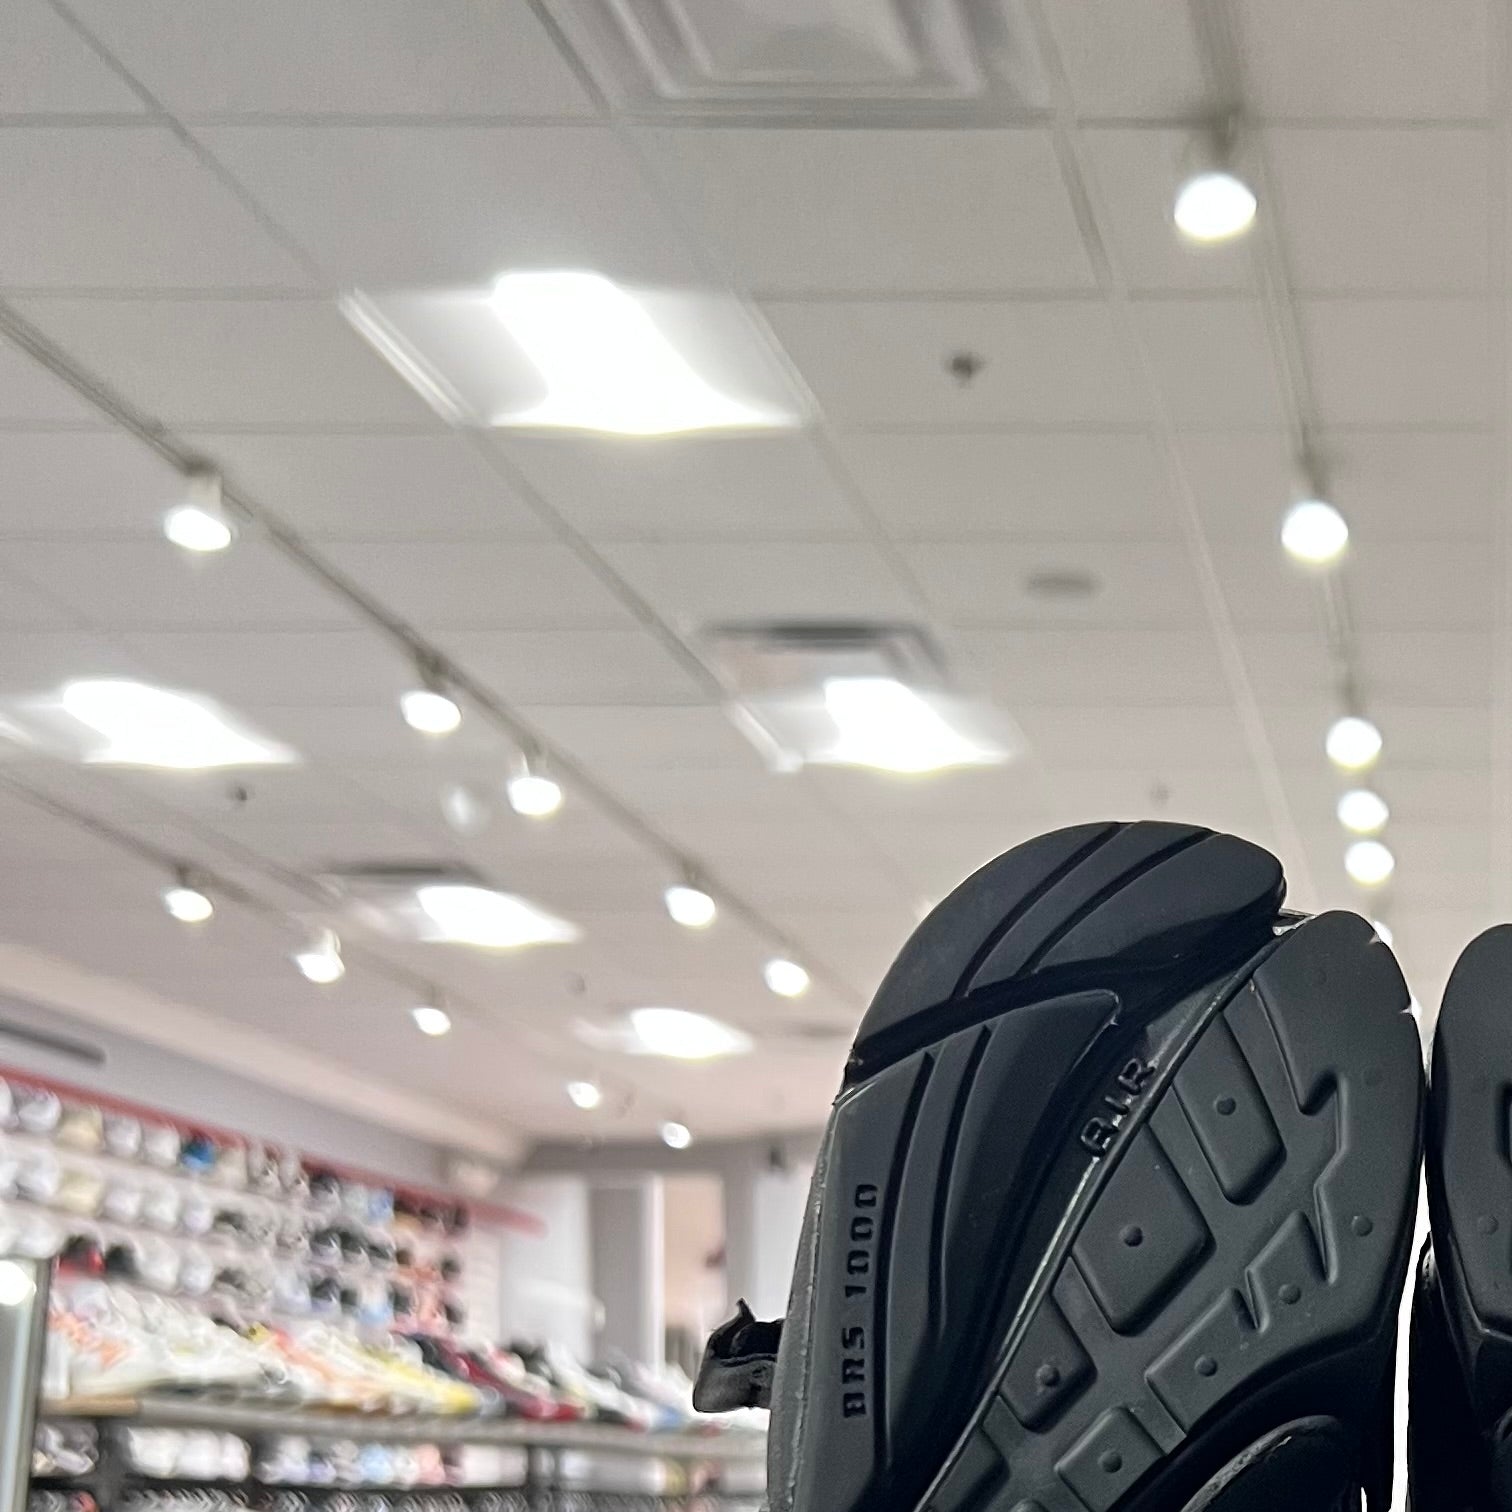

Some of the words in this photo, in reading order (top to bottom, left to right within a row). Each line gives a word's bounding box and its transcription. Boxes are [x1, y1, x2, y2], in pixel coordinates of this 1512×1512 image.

[1080, 1056, 1155, 1157] AIR
[844, 1183, 878, 1299] 1000
[841, 1326, 867, 1418] BRS
